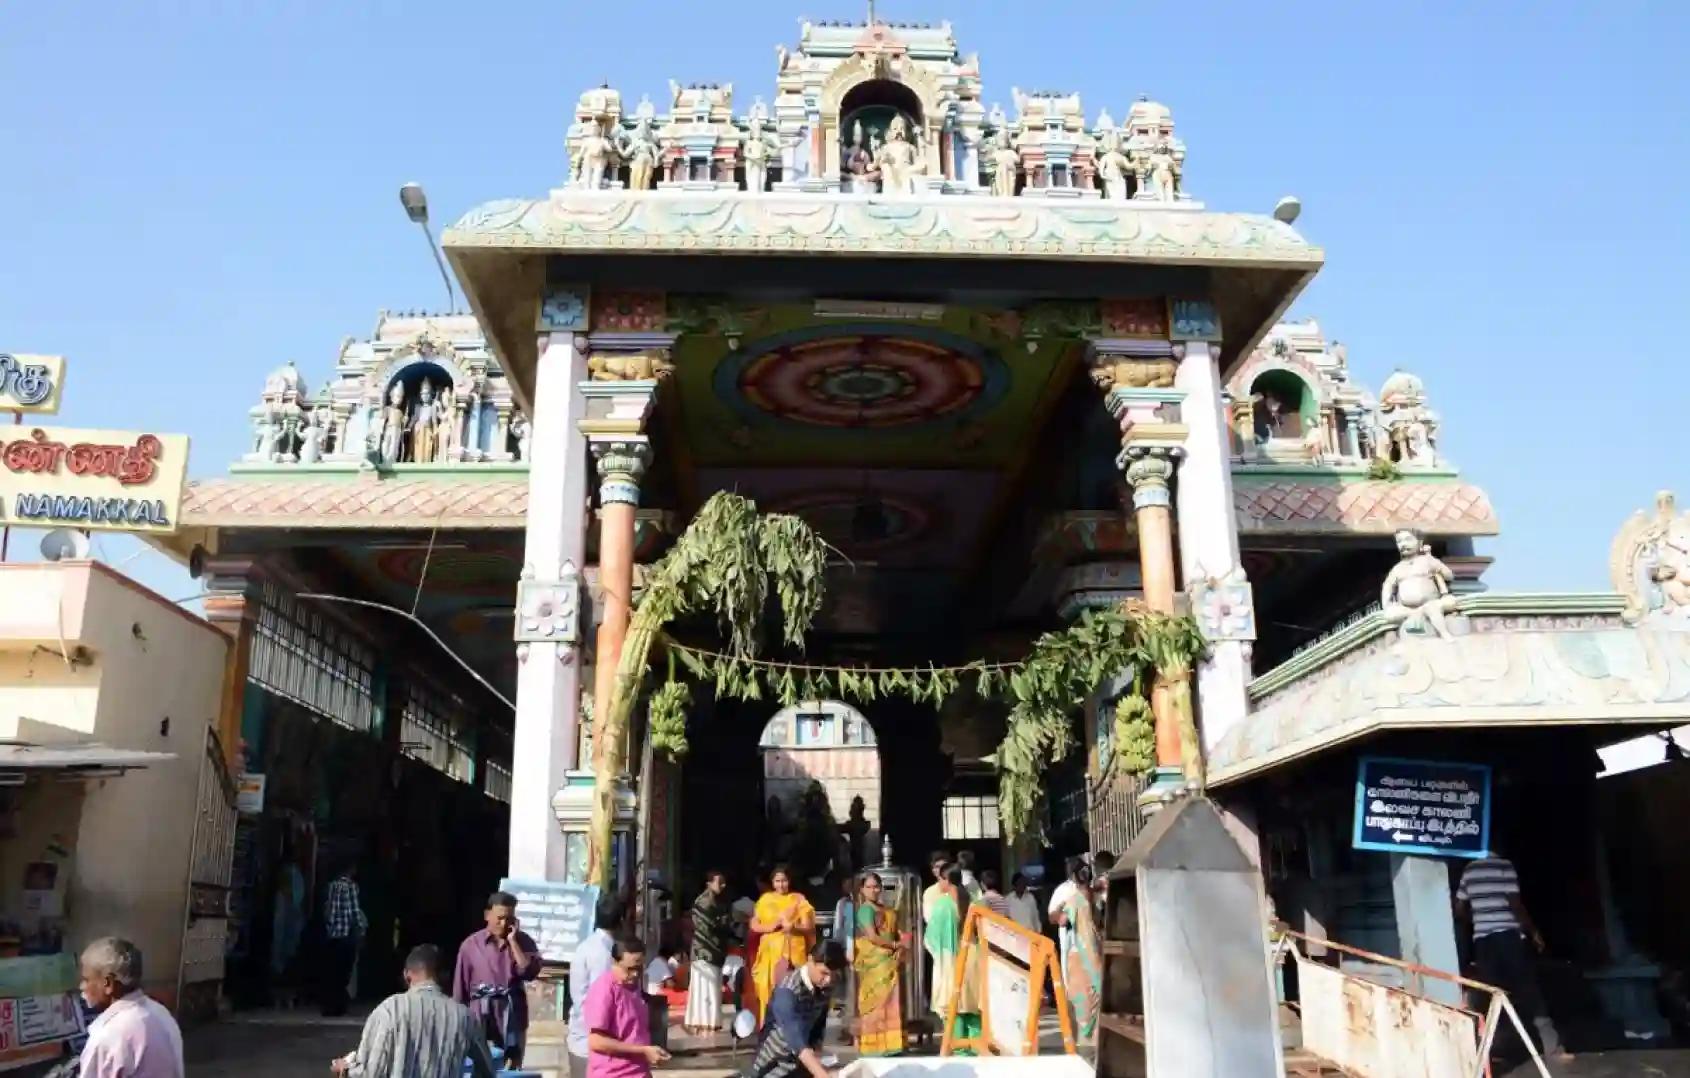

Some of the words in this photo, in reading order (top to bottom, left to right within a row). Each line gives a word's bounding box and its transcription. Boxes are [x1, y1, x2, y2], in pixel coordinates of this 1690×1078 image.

[16, 493, 169, 526] NAMAKKAL
[1370, 800, 1420, 814] இலவச
[1421, 804, 1472, 819] காலணி
[1365, 816, 1425, 832] பாதுகாப்பு
[1427, 819, 1480, 836] இடத்தில்
